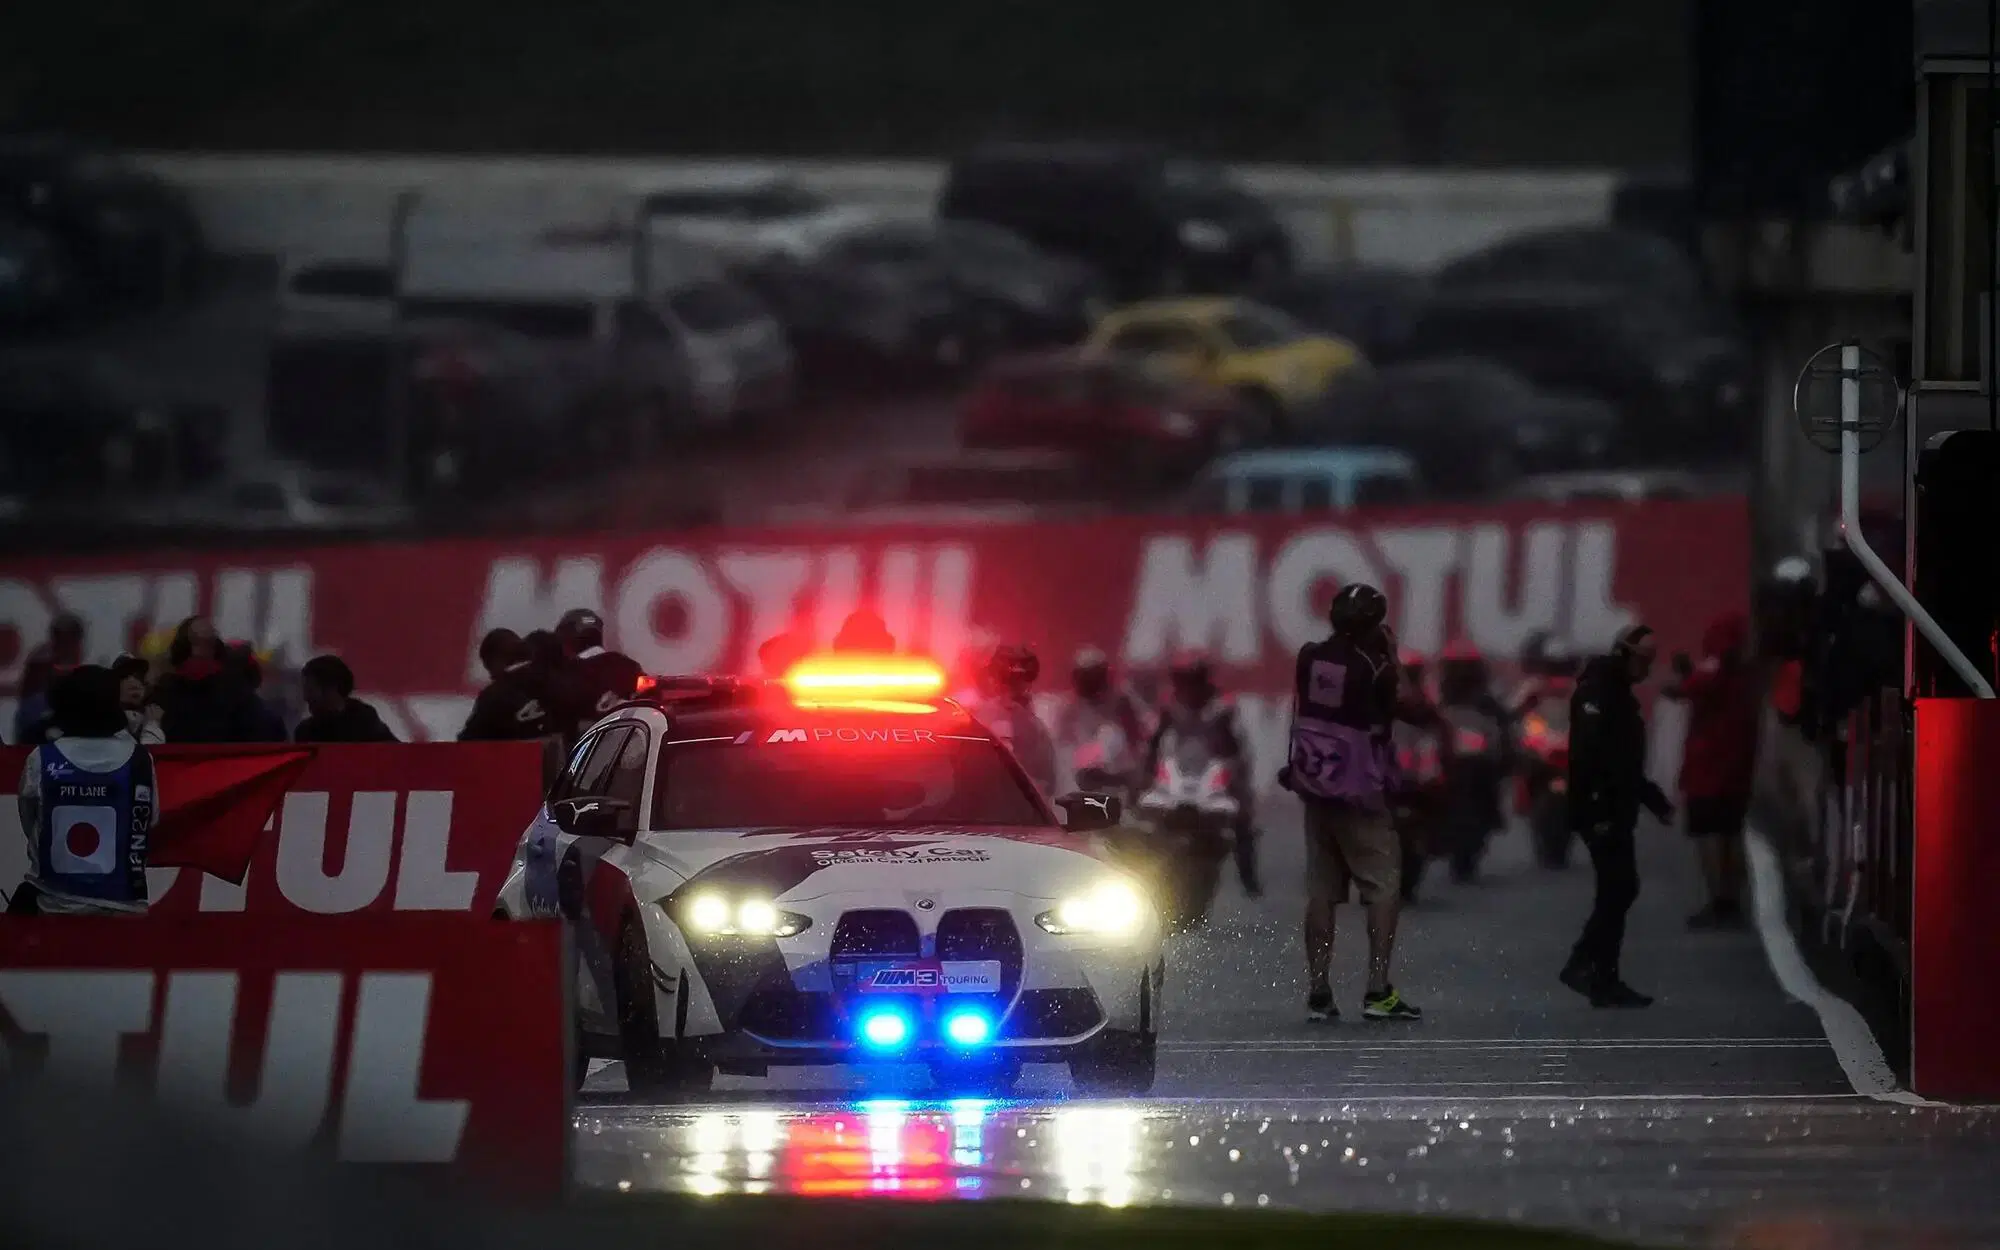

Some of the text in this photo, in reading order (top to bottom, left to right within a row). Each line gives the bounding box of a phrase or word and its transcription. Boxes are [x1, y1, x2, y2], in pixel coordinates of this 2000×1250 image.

[1122, 518, 1640, 664] MOTUL
[463, 545, 1000, 686] MOTUL
[813, 727, 938, 743] POWER
[60, 785, 108, 797] PIT LANE
[810, 847, 989, 859] Safety Car
[876, 857, 904, 865] Car
[942, 975, 989, 984] TOURING
